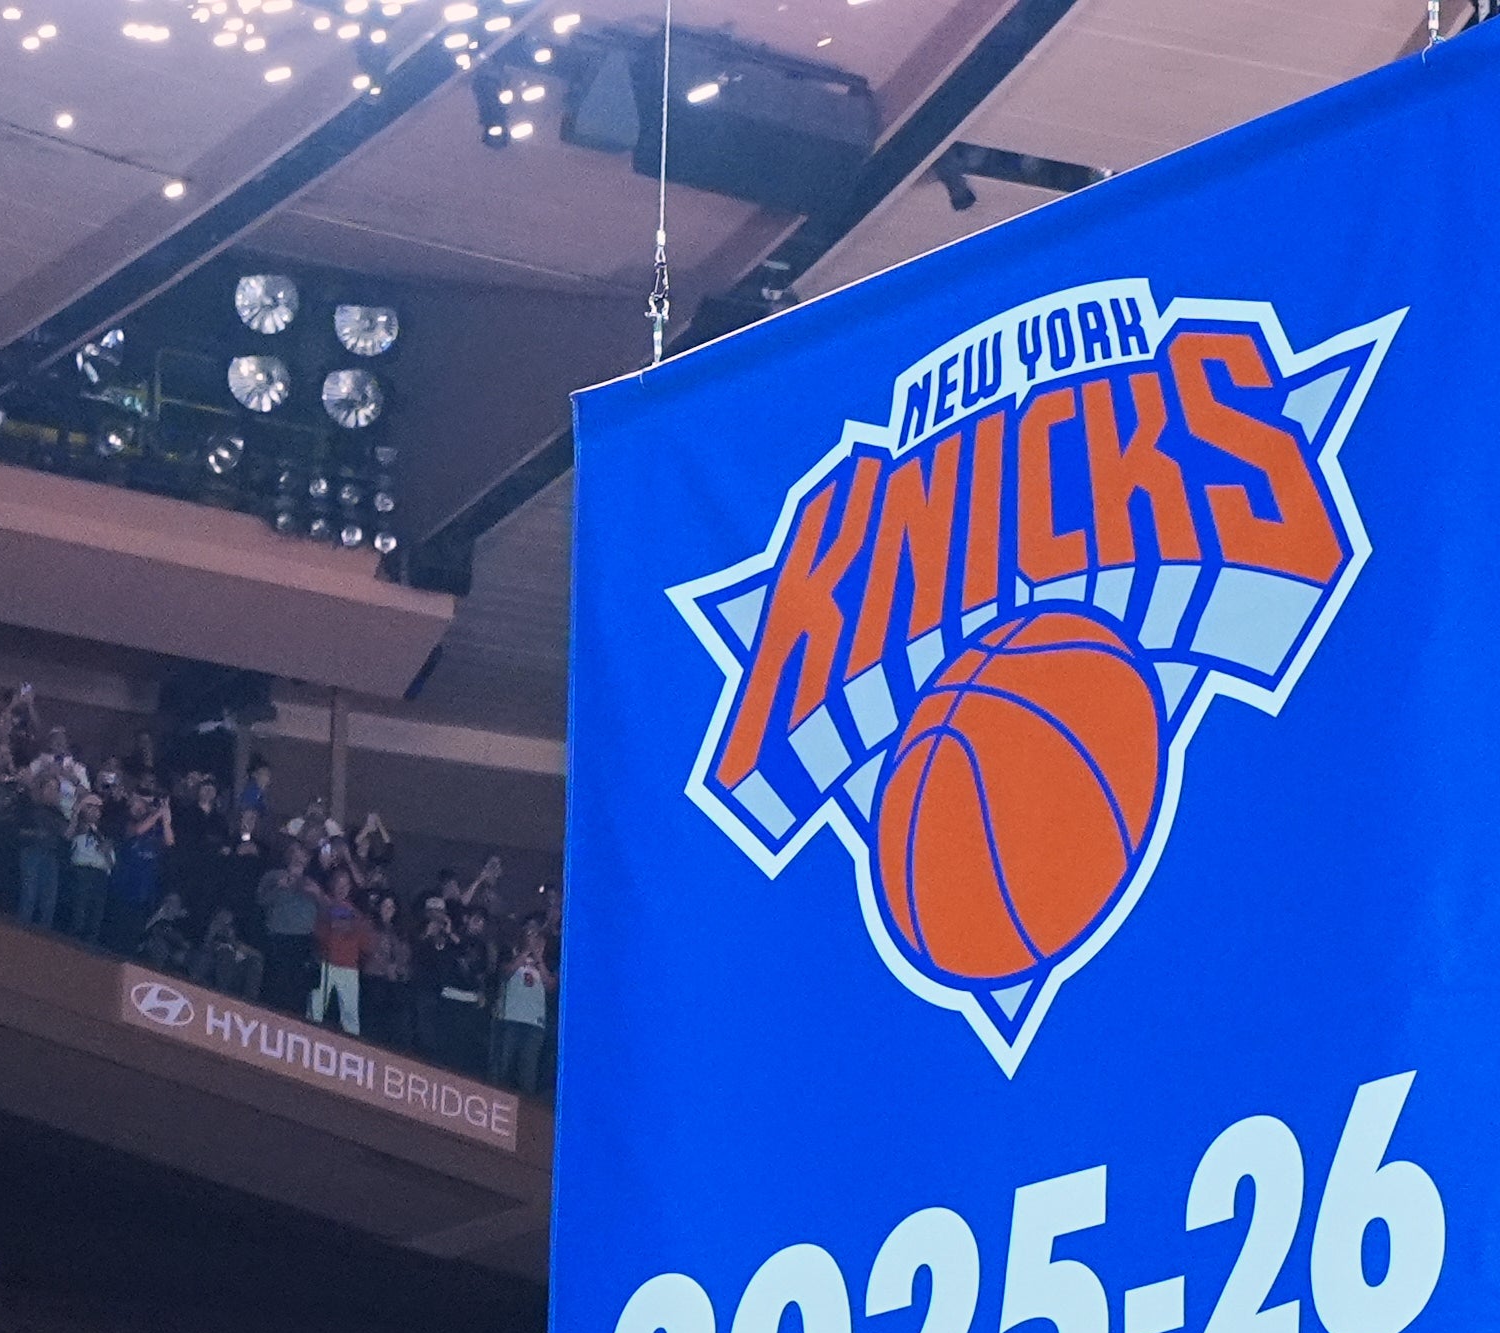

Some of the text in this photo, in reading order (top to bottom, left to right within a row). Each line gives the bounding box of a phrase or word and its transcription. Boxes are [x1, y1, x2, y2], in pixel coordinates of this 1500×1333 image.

[905, 296, 1151, 438] NEW YORK
[714, 330, 1346, 791] KNICKS
[206, 1004, 511, 1138] HYUNDAI BRIDGE
